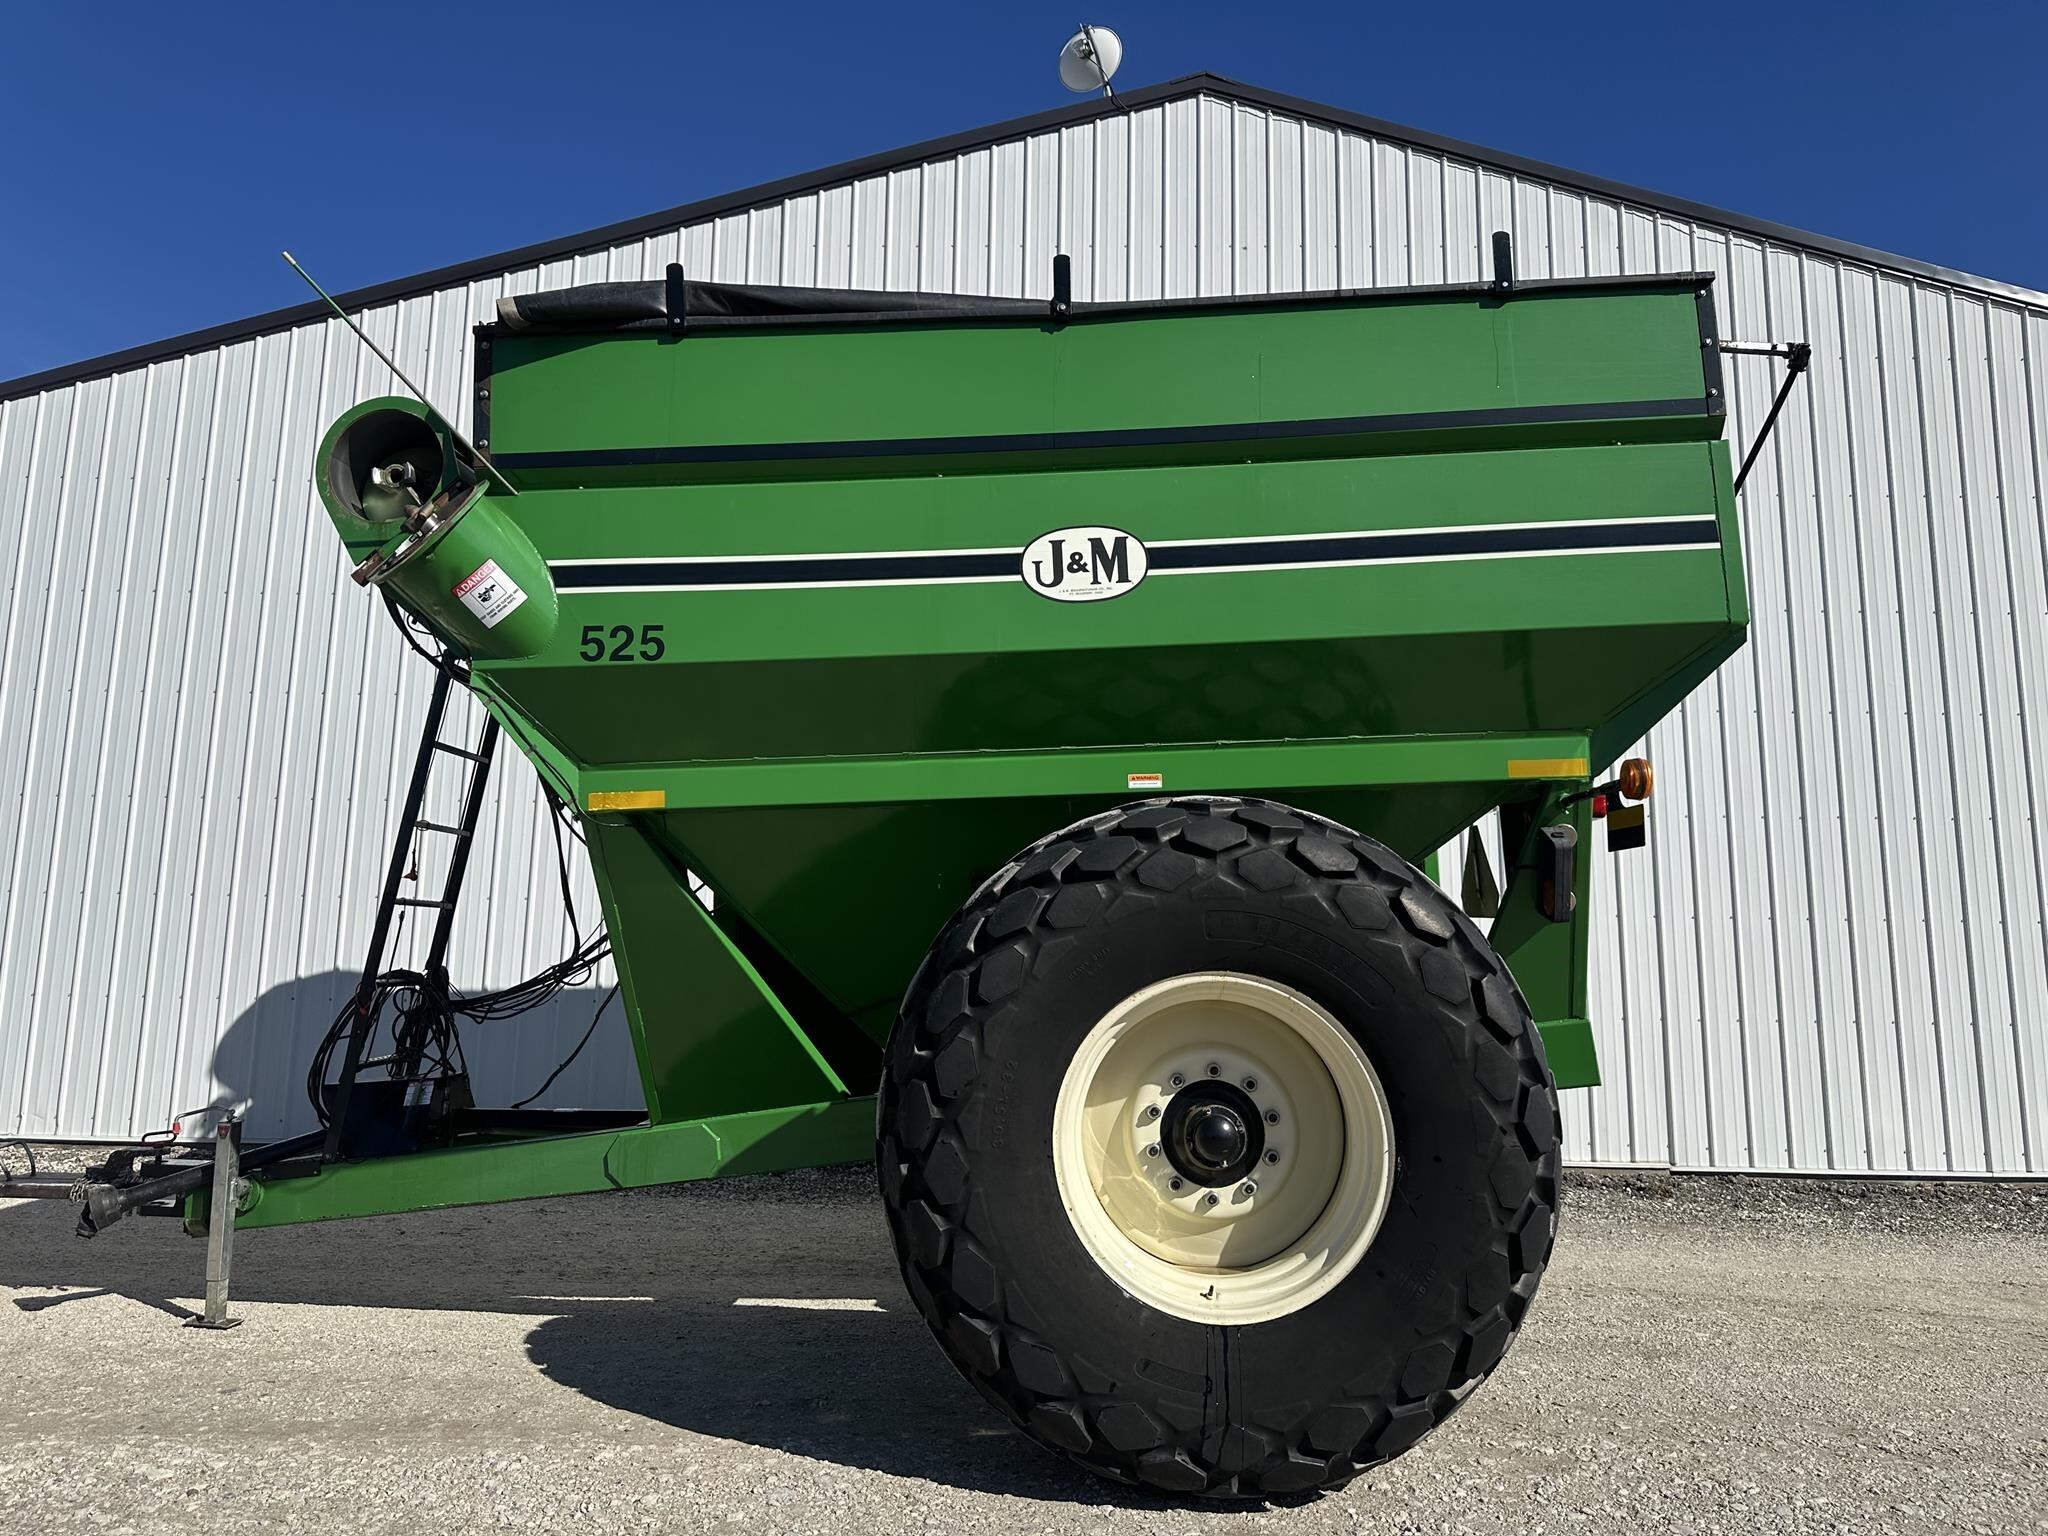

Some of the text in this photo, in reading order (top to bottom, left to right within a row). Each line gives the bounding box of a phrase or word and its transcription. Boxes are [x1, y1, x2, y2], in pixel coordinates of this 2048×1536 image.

[460, 561, 497, 592] DANGER
[1031, 535, 1132, 588] J&M
[579, 624, 666, 663] 525
